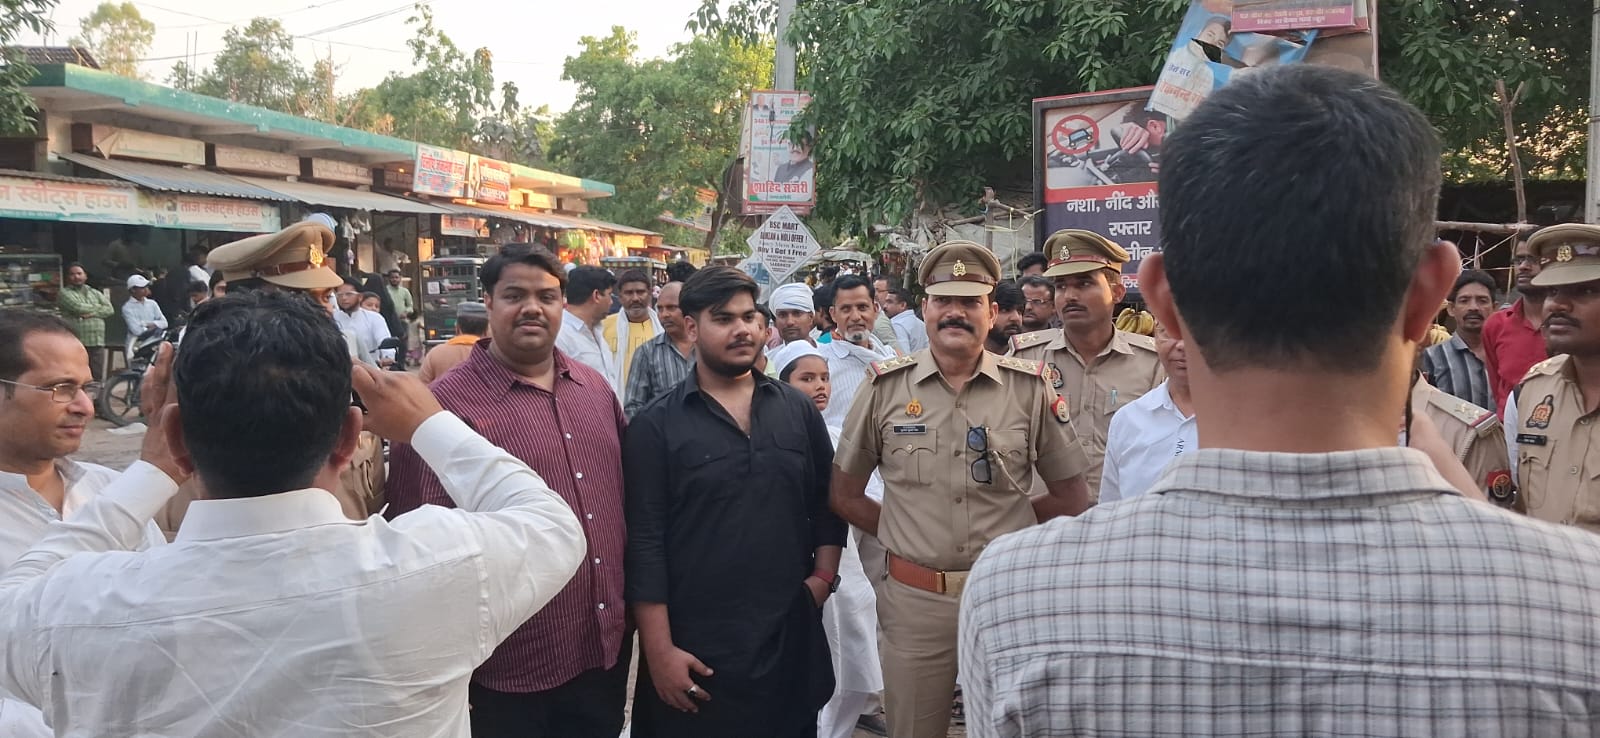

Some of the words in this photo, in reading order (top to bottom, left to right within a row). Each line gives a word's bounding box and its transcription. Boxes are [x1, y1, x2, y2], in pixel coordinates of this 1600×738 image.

[753, 180, 781, 193] शाहिद
[16, 182, 78, 210] स्वीट्स
[83, 191, 128, 209] हाउस
[1066, 197, 1100, 213] नशा,
[1105, 190, 1134, 211] नींद
[180, 200, 201, 213] ताज
[769, 221, 781, 230] BSC
[782, 221, 800, 231] MART
[1108, 220, 1153, 236] रफ्तार
[791, 233, 804, 243] OFFER
[758, 246, 769, 254] Buy
[774, 247, 786, 255] Get
